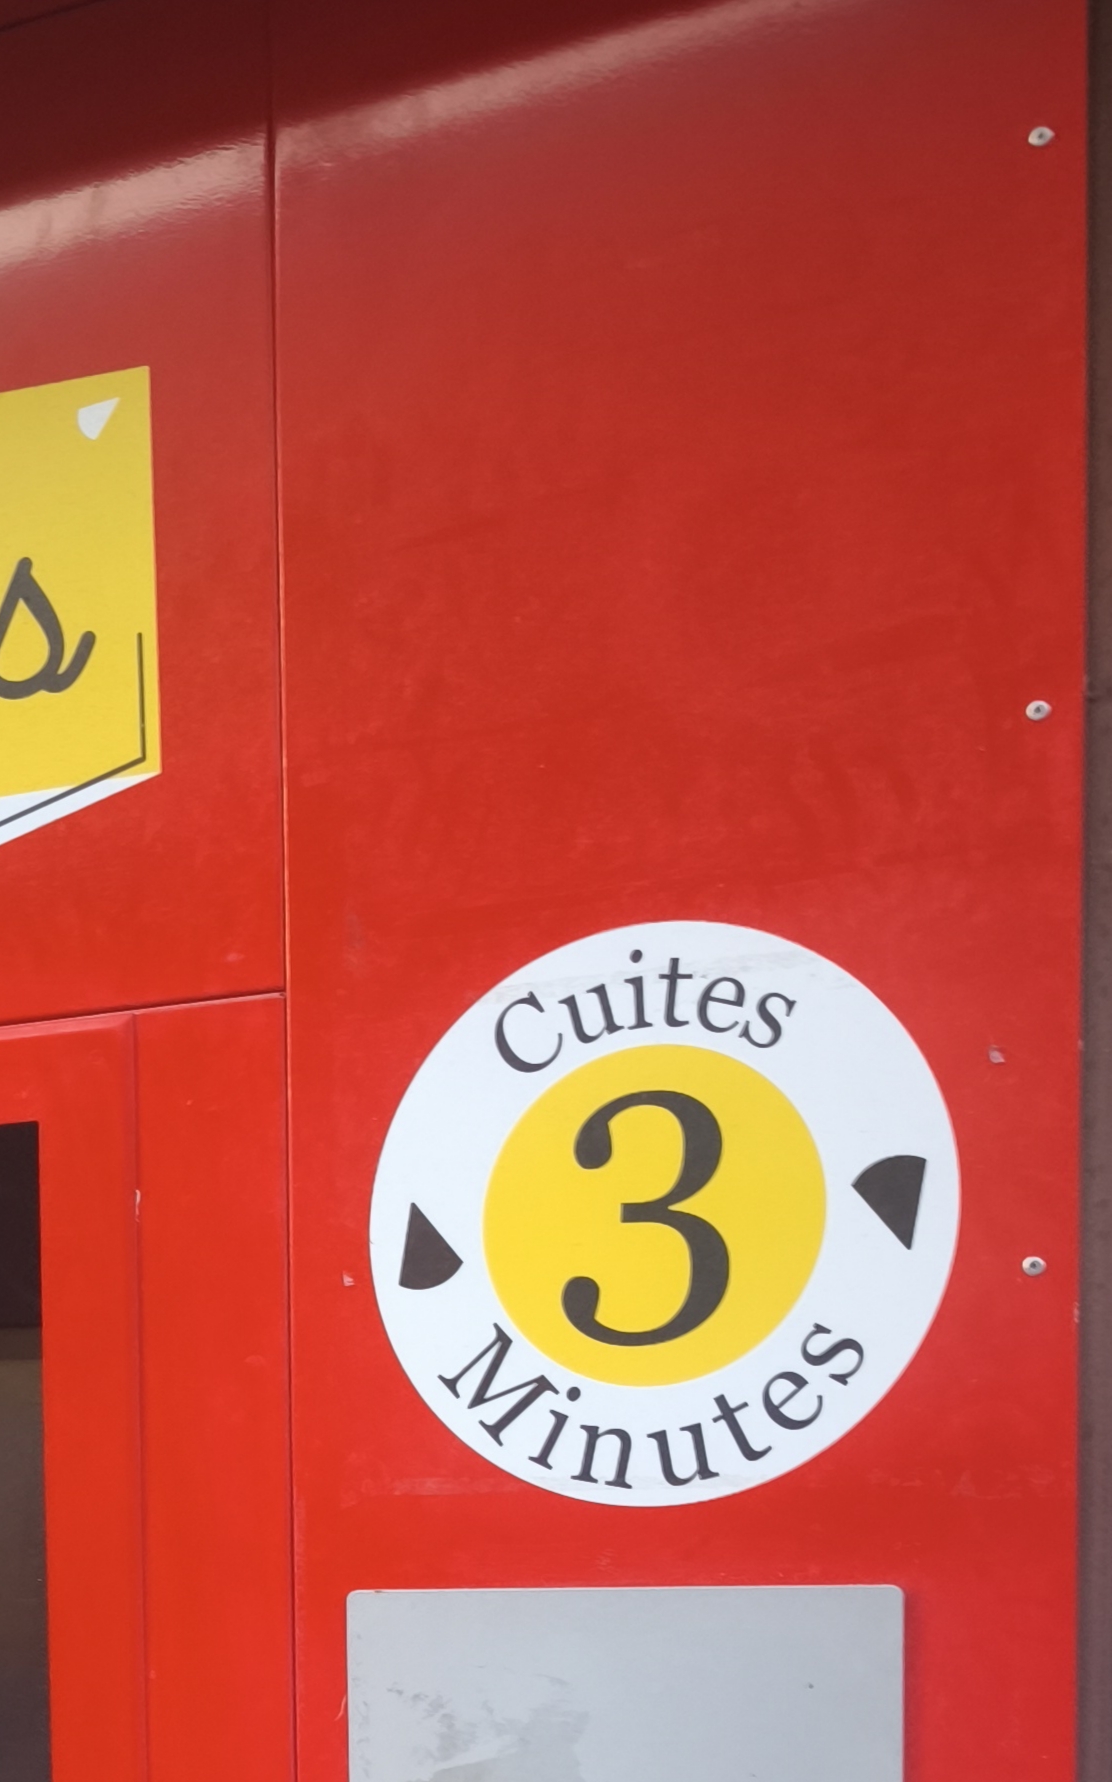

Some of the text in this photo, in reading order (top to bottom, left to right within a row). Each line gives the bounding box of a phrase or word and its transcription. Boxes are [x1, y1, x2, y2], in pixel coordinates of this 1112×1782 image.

[494, 949, 797, 1073] Cuites
[561, 1090, 730, 1347] 3
[437, 1322, 865, 1490] Minutes
